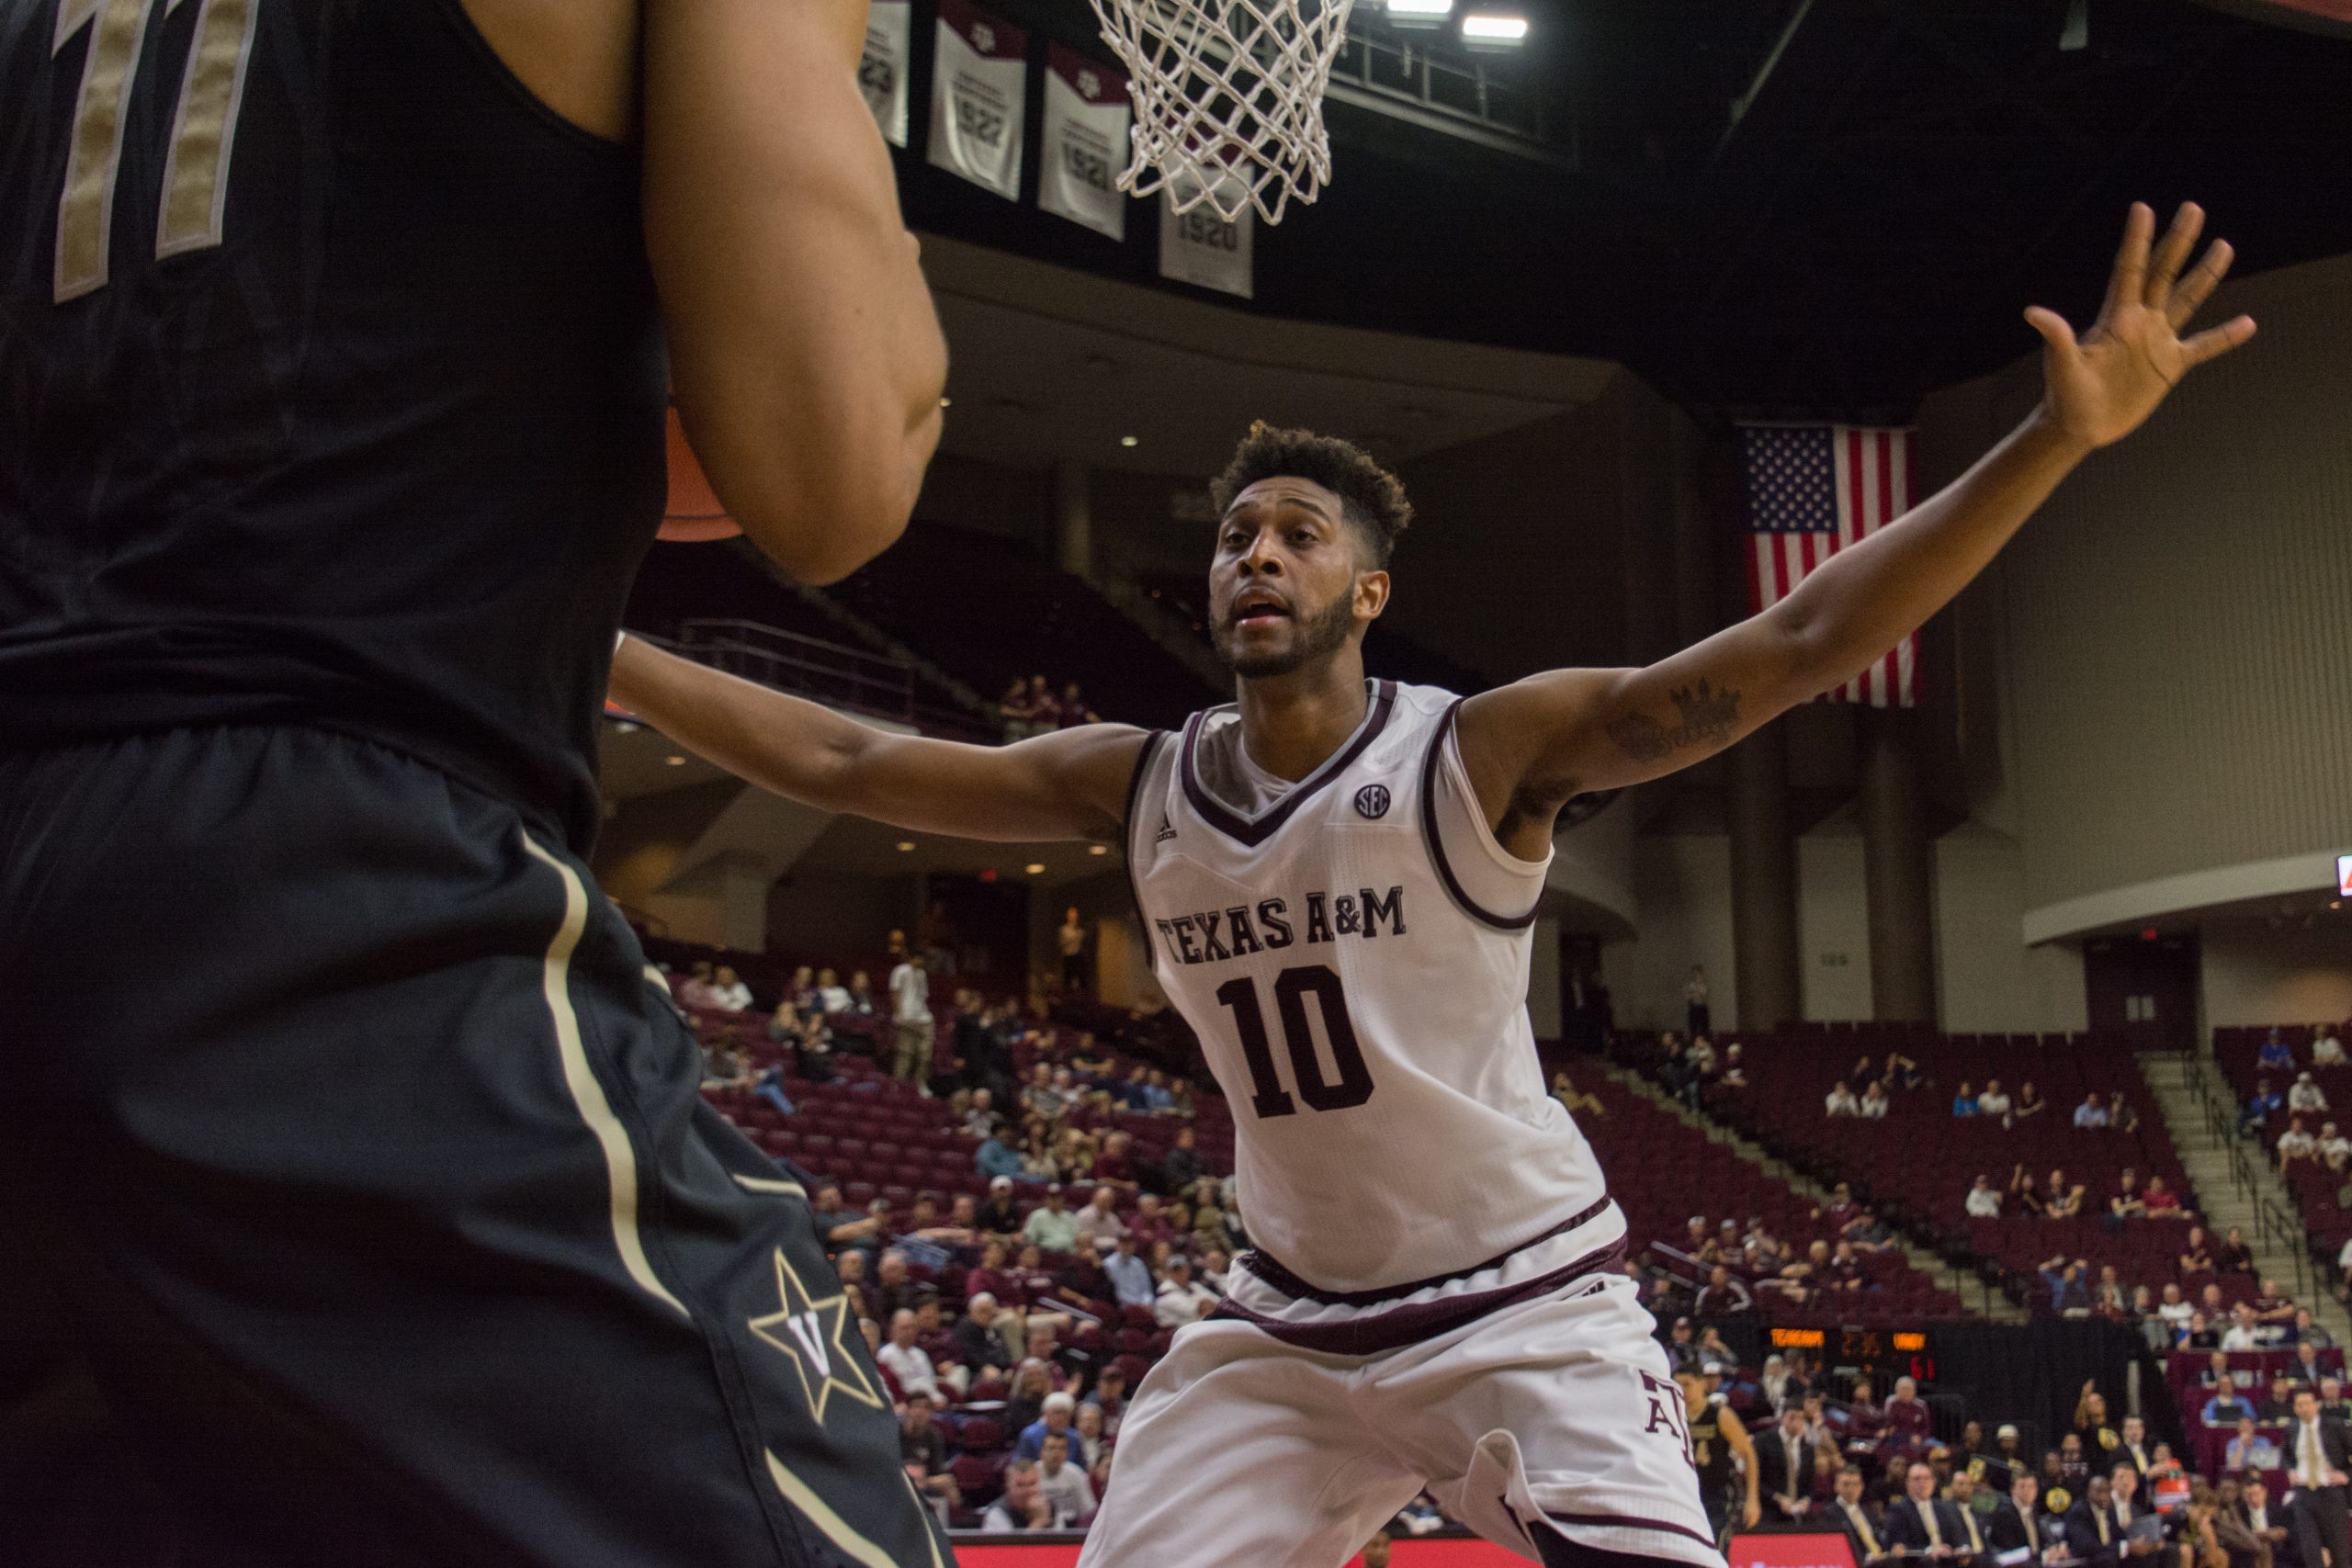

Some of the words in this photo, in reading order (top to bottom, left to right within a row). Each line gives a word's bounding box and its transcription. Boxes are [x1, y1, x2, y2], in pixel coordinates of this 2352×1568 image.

[1179, 211, 1237, 252] 1920
[1358, 786, 1388, 817] SEC
[1156, 897, 1294, 964] TEXAS
[1306, 886, 1407, 943] A&M
[1216, 964, 1374, 1119] 10
[787, 1311, 831, 1378] V
